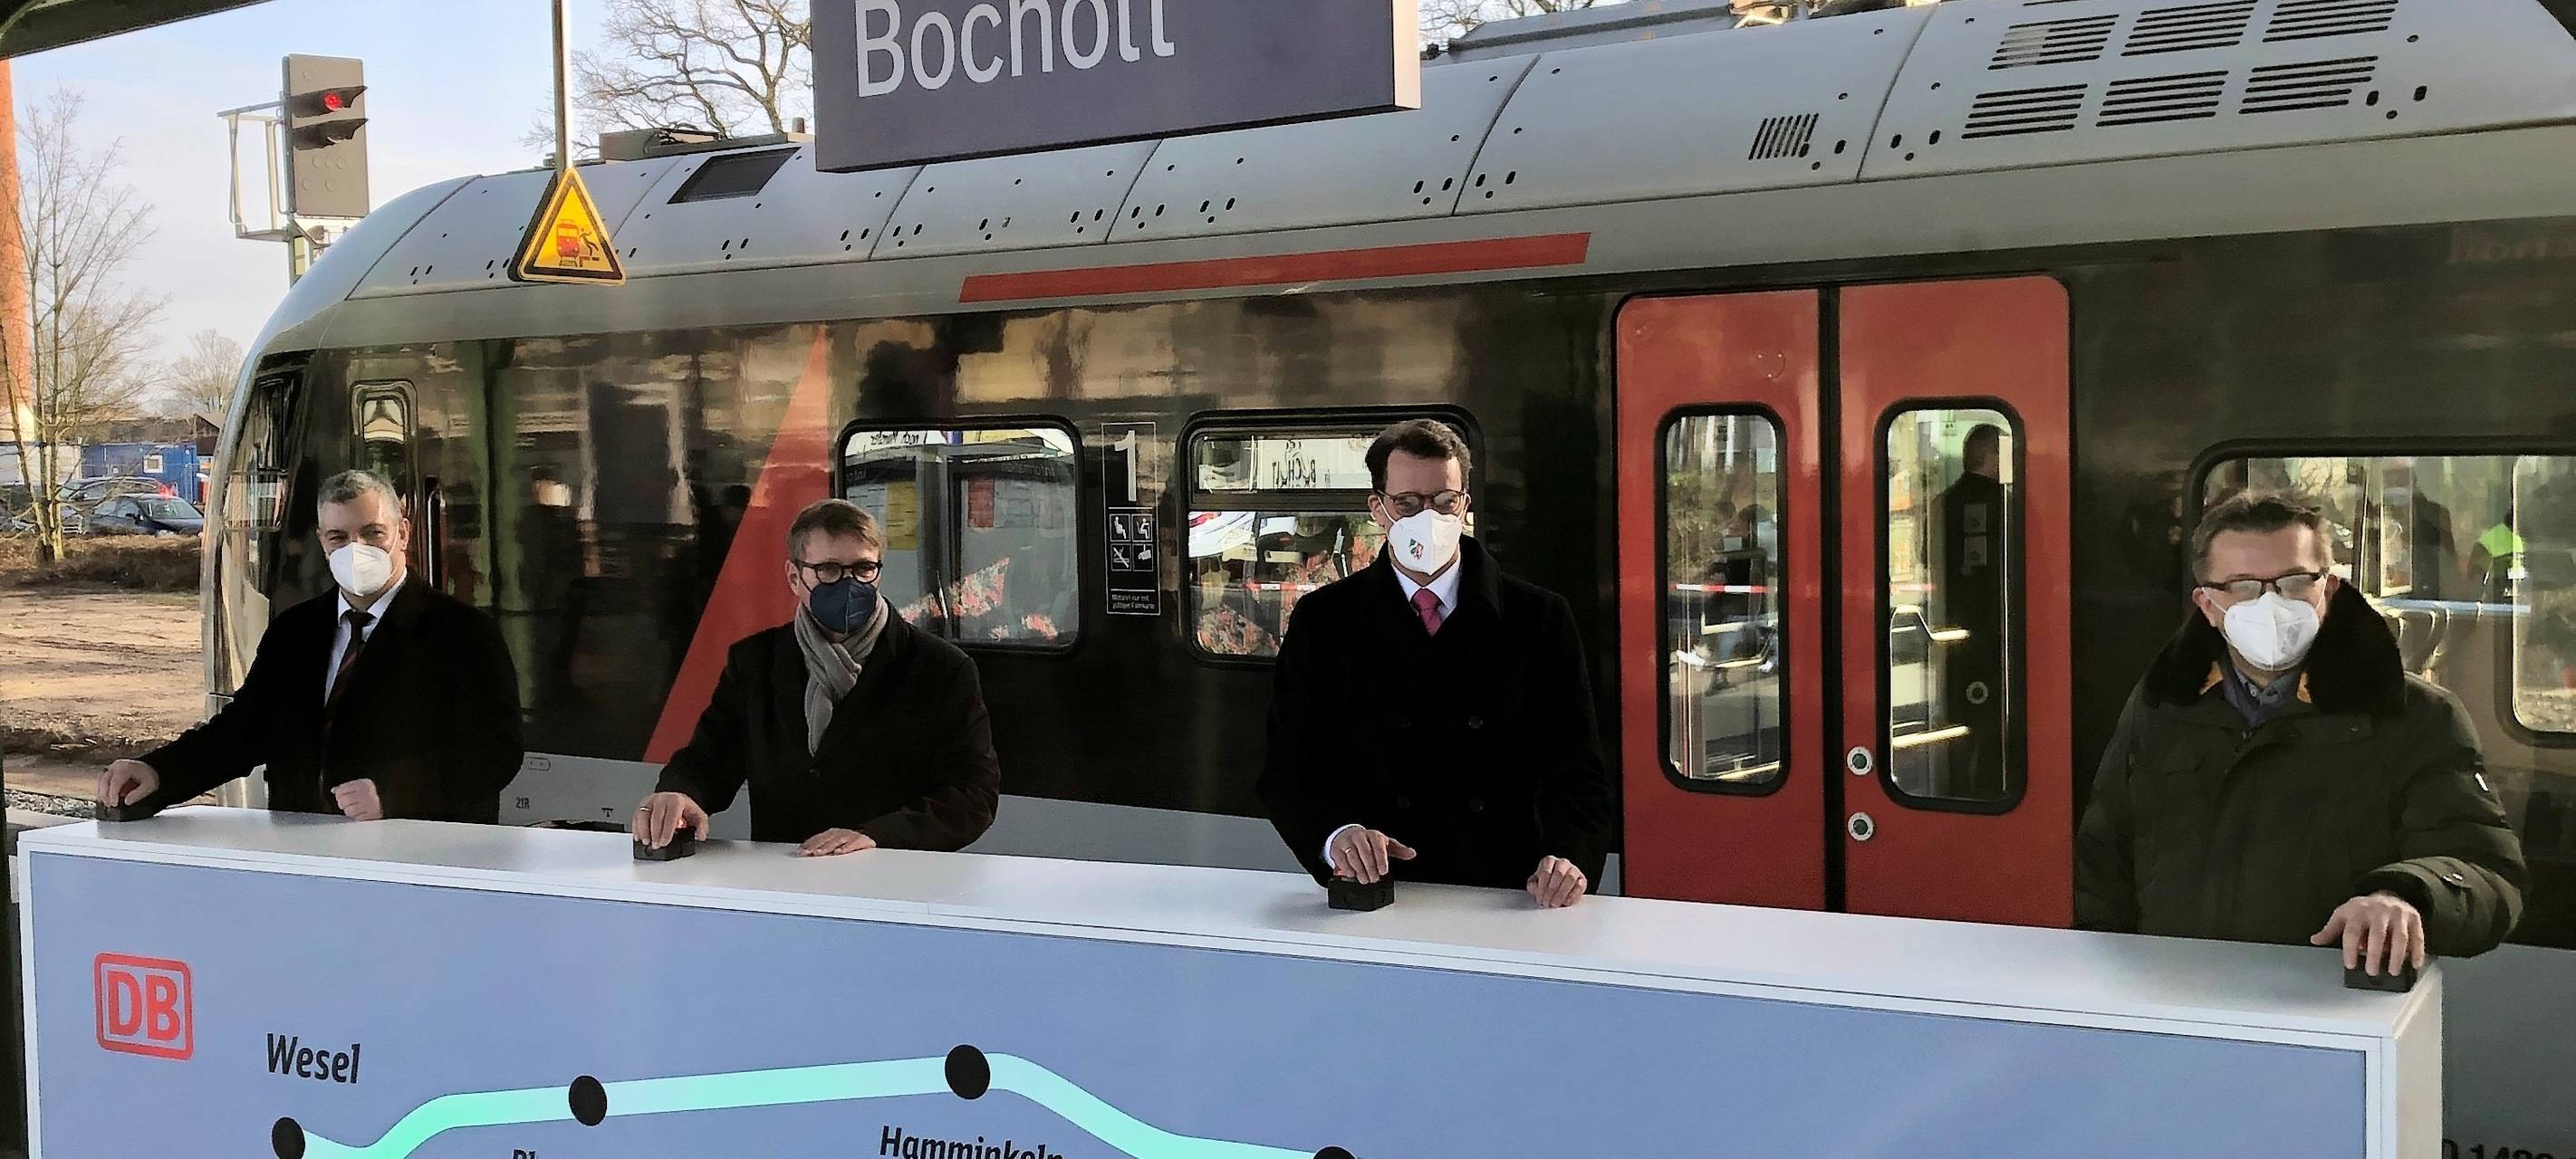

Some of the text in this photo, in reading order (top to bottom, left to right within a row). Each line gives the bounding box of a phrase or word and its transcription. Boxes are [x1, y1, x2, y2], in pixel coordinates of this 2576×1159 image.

[855, 0, 1175, 98] Bocholt
[1115, 430, 1137, 502] 1
[107, 971, 180, 1042] DB
[266, 1032, 361, 1084] Wesel
